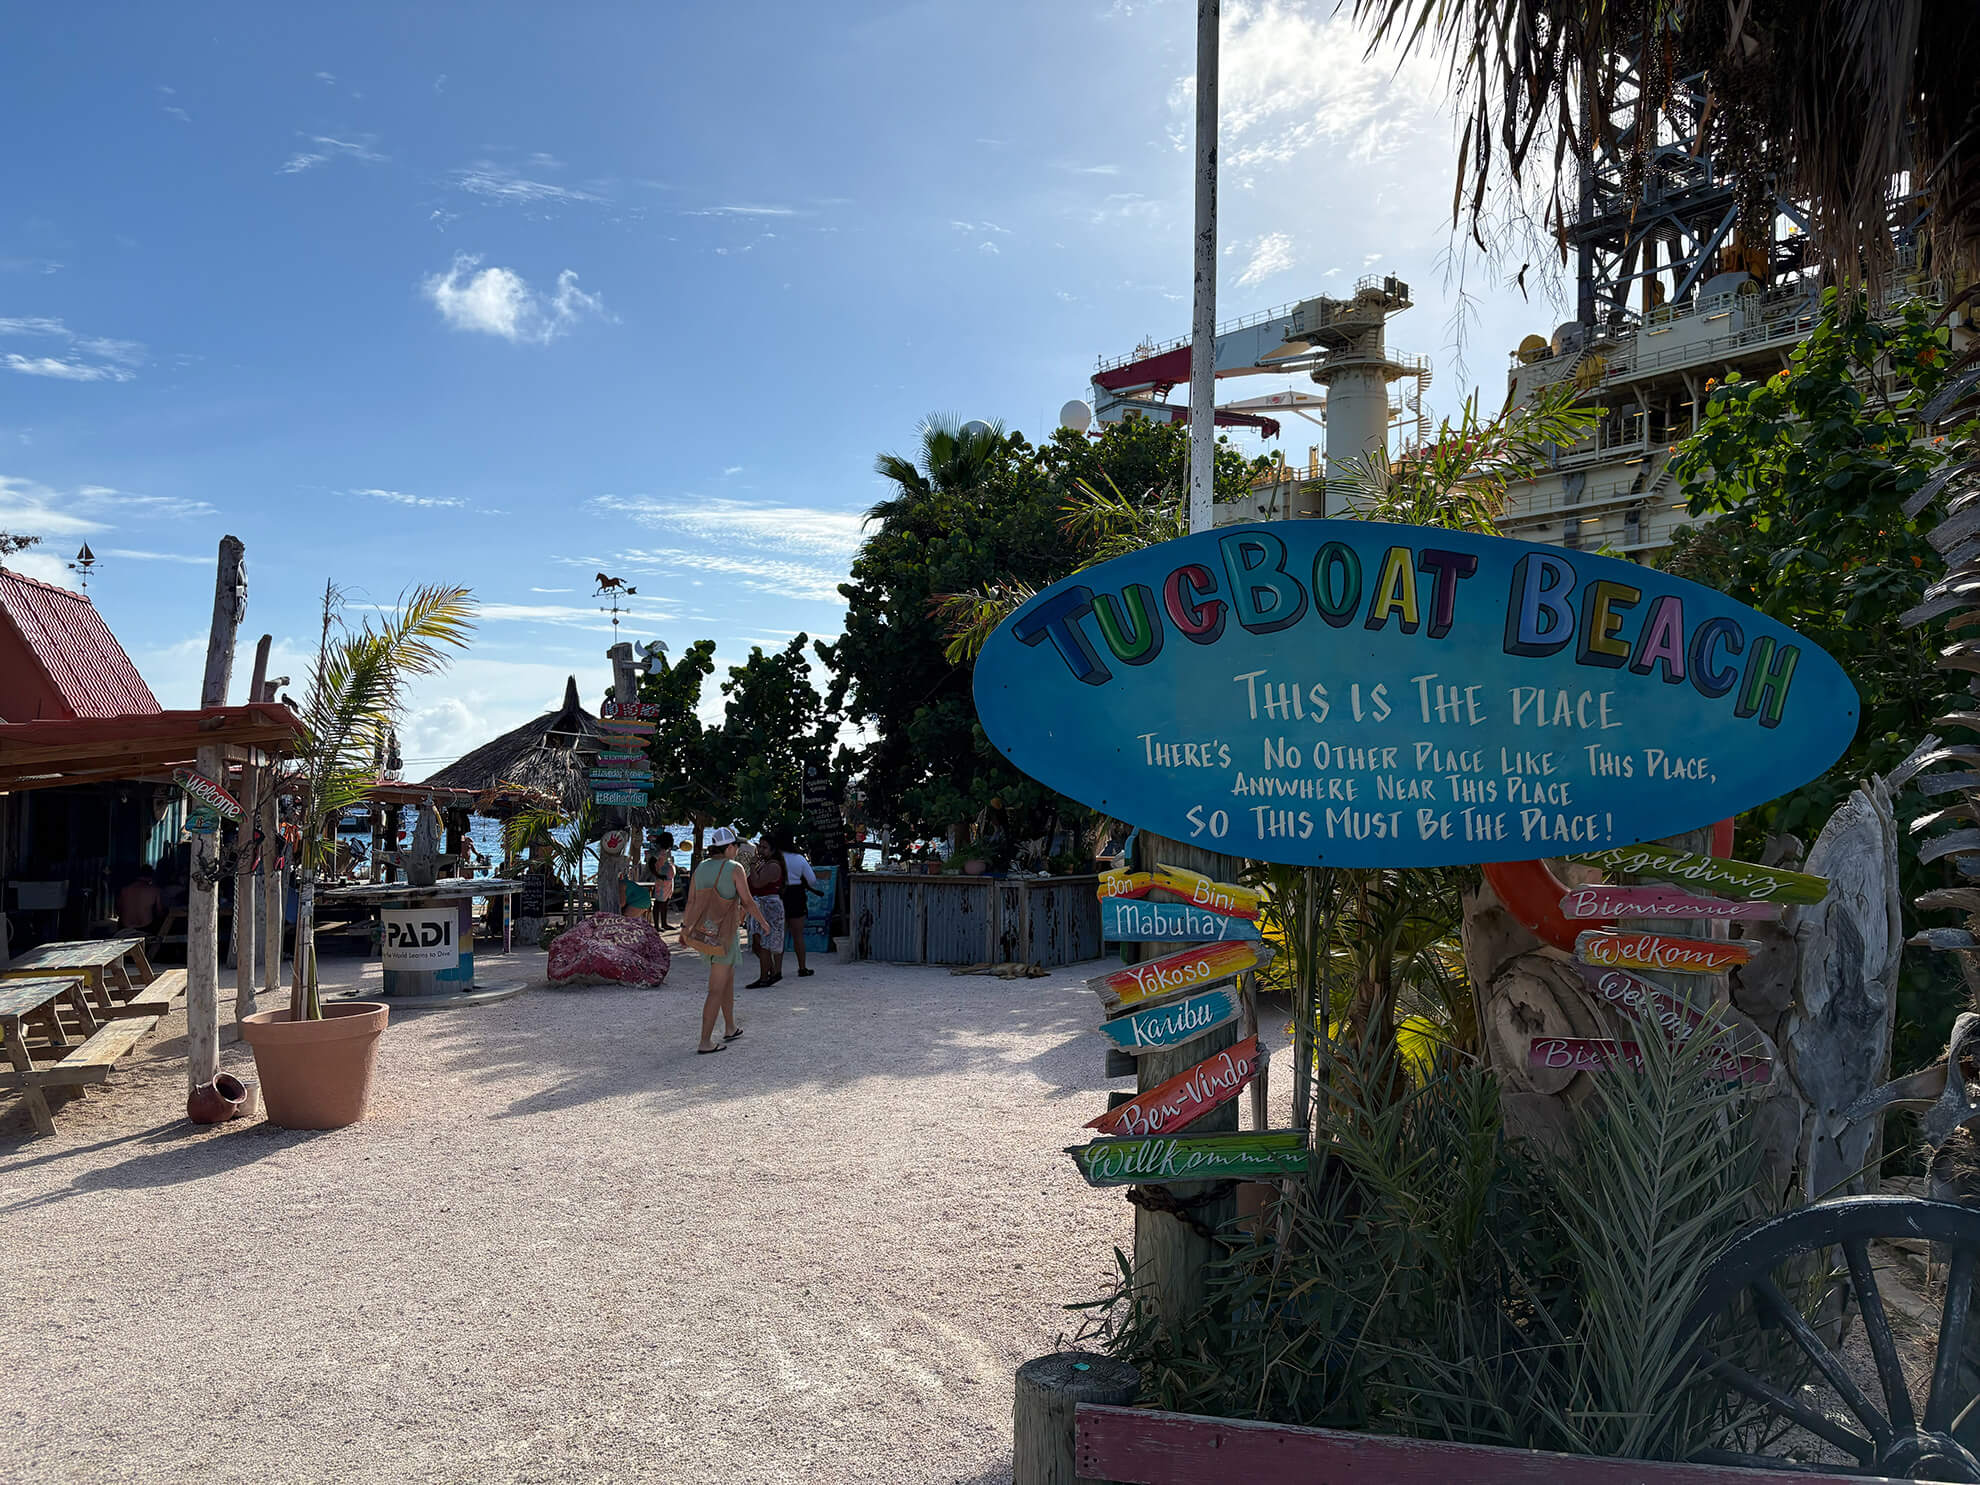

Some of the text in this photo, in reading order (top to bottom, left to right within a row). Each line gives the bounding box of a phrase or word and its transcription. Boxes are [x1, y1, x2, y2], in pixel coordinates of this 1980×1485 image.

[1011, 531, 1800, 728] TUGBOAT BEACH
[1233, 670, 1622, 729] THIS IS THE PLACE
[1137, 733, 1717, 783] THERE'S NO OTHER PLACE LIKE THIS PLACE,
[185, 774, 240, 818] Welcome
[1232, 772, 1572, 806] ANYWHERE NEAR THIS PLACE
[1186, 805, 1614, 843] SO THIS MUST BE THE PLACE!
[1107, 875, 1236, 911] Bon Bini
[1565, 848, 1794, 898] oşgeldiniz
[1116, 905, 1230, 941] Mabuhay
[1572, 891, 1751, 918] Bienvenue
[388, 921, 451, 947] PADI
[1589, 936, 1732, 967] Welkom
[1131, 1000, 1213, 1048] Karibu
[1116, 1054, 1249, 1137] Ben-Vindo
